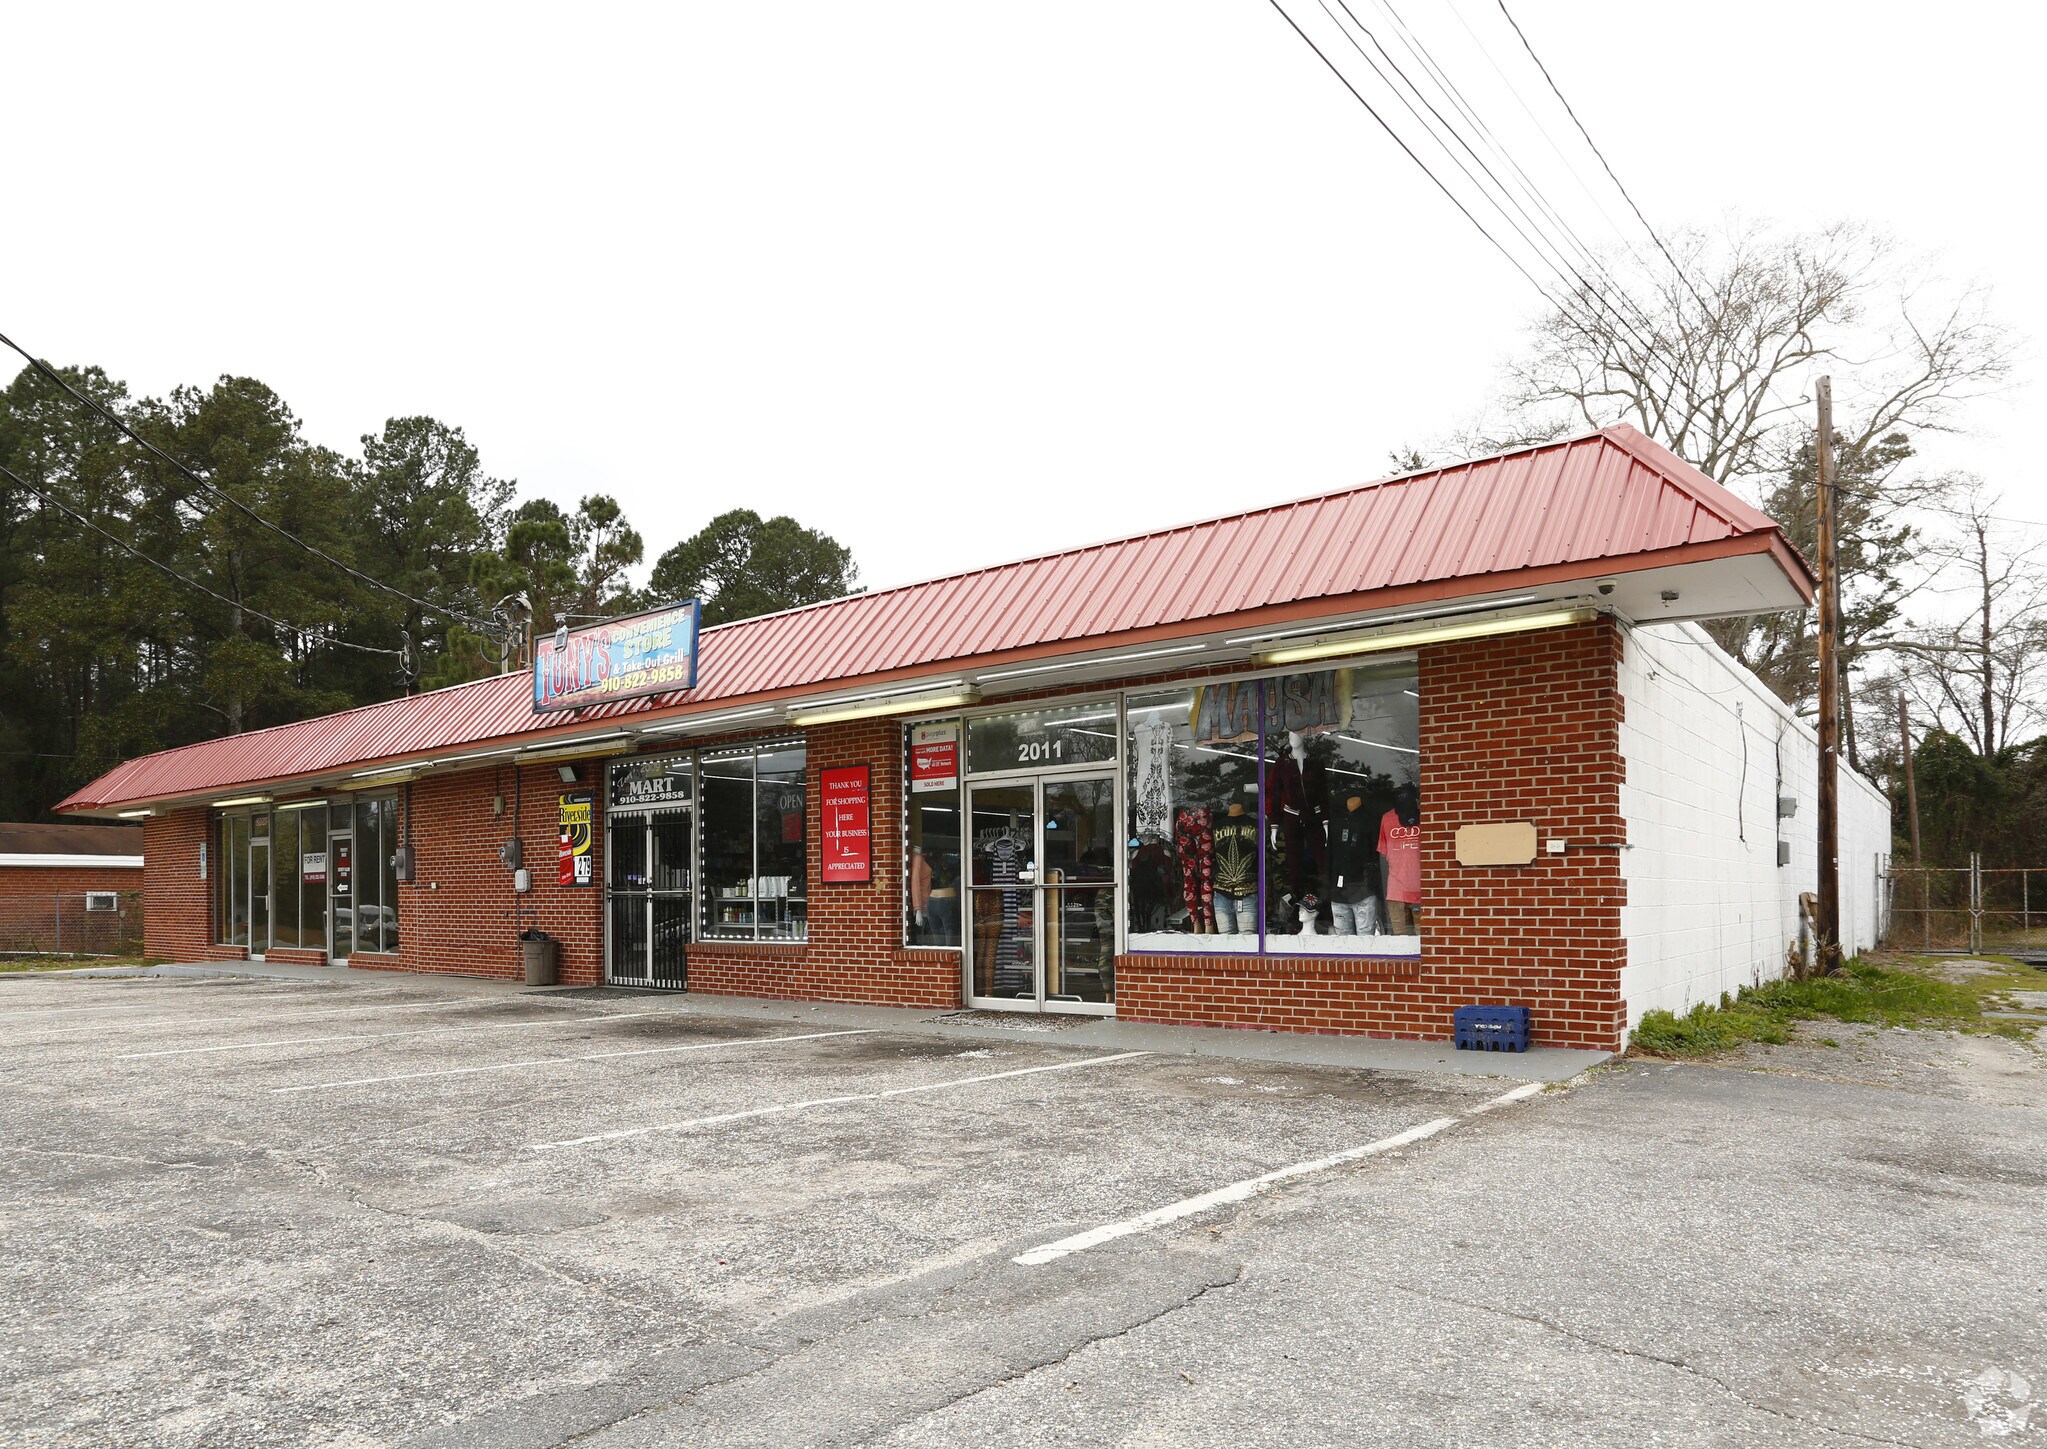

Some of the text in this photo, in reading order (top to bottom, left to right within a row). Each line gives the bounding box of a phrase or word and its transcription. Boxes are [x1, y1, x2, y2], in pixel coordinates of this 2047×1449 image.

[610, 608, 686, 643] CONVENIENCE
[623, 629, 673, 659] STORE
[538, 627, 612, 706] TONY'S
[613, 663, 621, 675] &
[601, 665, 684, 693] 910-822-9858
[1018, 740, 1061, 761] 2011
[629, 777, 674, 795] MART
[829, 780, 862, 789] THANK YOU
[620, 791, 684, 804] 910-822-9858
[780, 794, 803, 809] OPEN
[826, 796, 866, 806] FOR SHOPPING
[559, 806, 590, 823] Riverside
[841, 829, 867, 837] BUSINESS
[304, 855, 325, 864] FOR RENT
[828, 862, 865, 870] APPRECIATED
